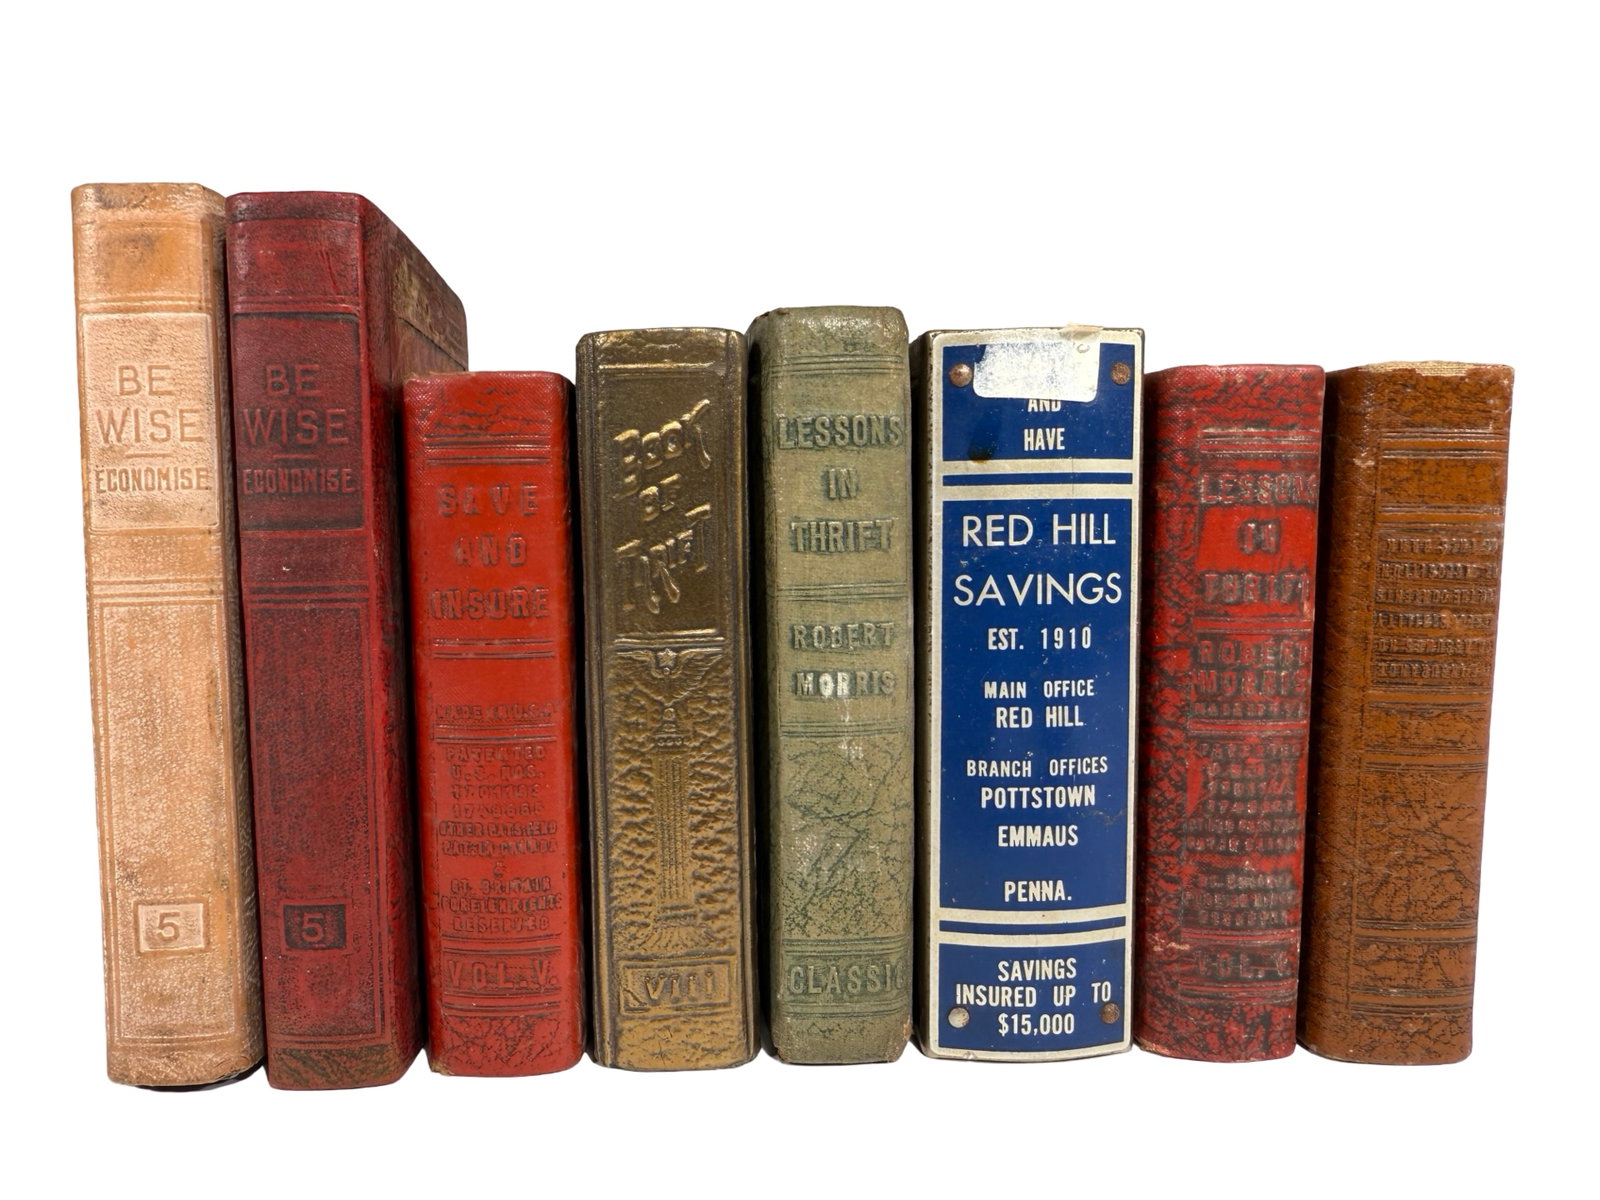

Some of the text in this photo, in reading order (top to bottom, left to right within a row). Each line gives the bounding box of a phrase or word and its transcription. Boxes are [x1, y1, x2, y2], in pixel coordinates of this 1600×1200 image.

[117, 363, 175, 397] BE
[264, 363, 322, 397] BE
[95, 407, 203, 443] WISE
[243, 408, 350, 444] WISE
[776, 413, 905, 450] LESSONS
[1023, 427, 1066, 451] HAVE
[95, 466, 211, 494] ECONOMISE
[242, 466, 355, 495] ECONOMISE
[823, 466, 859, 500] IN
[437, 483, 539, 517] SAVE
[789, 518, 896, 554] THRIFT
[962, 513, 1117, 547] RED HILL
[454, 533, 527, 567] AND
[430, 587, 551, 620] INSURE
[953, 572, 1123, 607] SAVINGS
[790, 621, 897, 652] ROBERT
[987, 626, 1092, 651] EST. 1910
[793, 669, 898, 698] MORRIS
[984, 679, 1095, 699] MAIN OFFICE
[995, 705, 1085, 729] RED HILL
[966, 756, 1108, 778] BRANCH OFFICES
[981, 785, 1096, 809] POTTSTOWN
[998, 825, 1078, 847] EMMAUS
[1004, 880, 1072, 902] PENNA.
[157, 910, 181, 942] 5
[301, 912, 329, 941] 5
[788, 964, 906, 995] CLASSIC
[998, 957, 1077, 982] SAVINGS
[956, 981, 1111, 1007] INSURED UP TO
[998, 1012, 1075, 1037] $15,000
